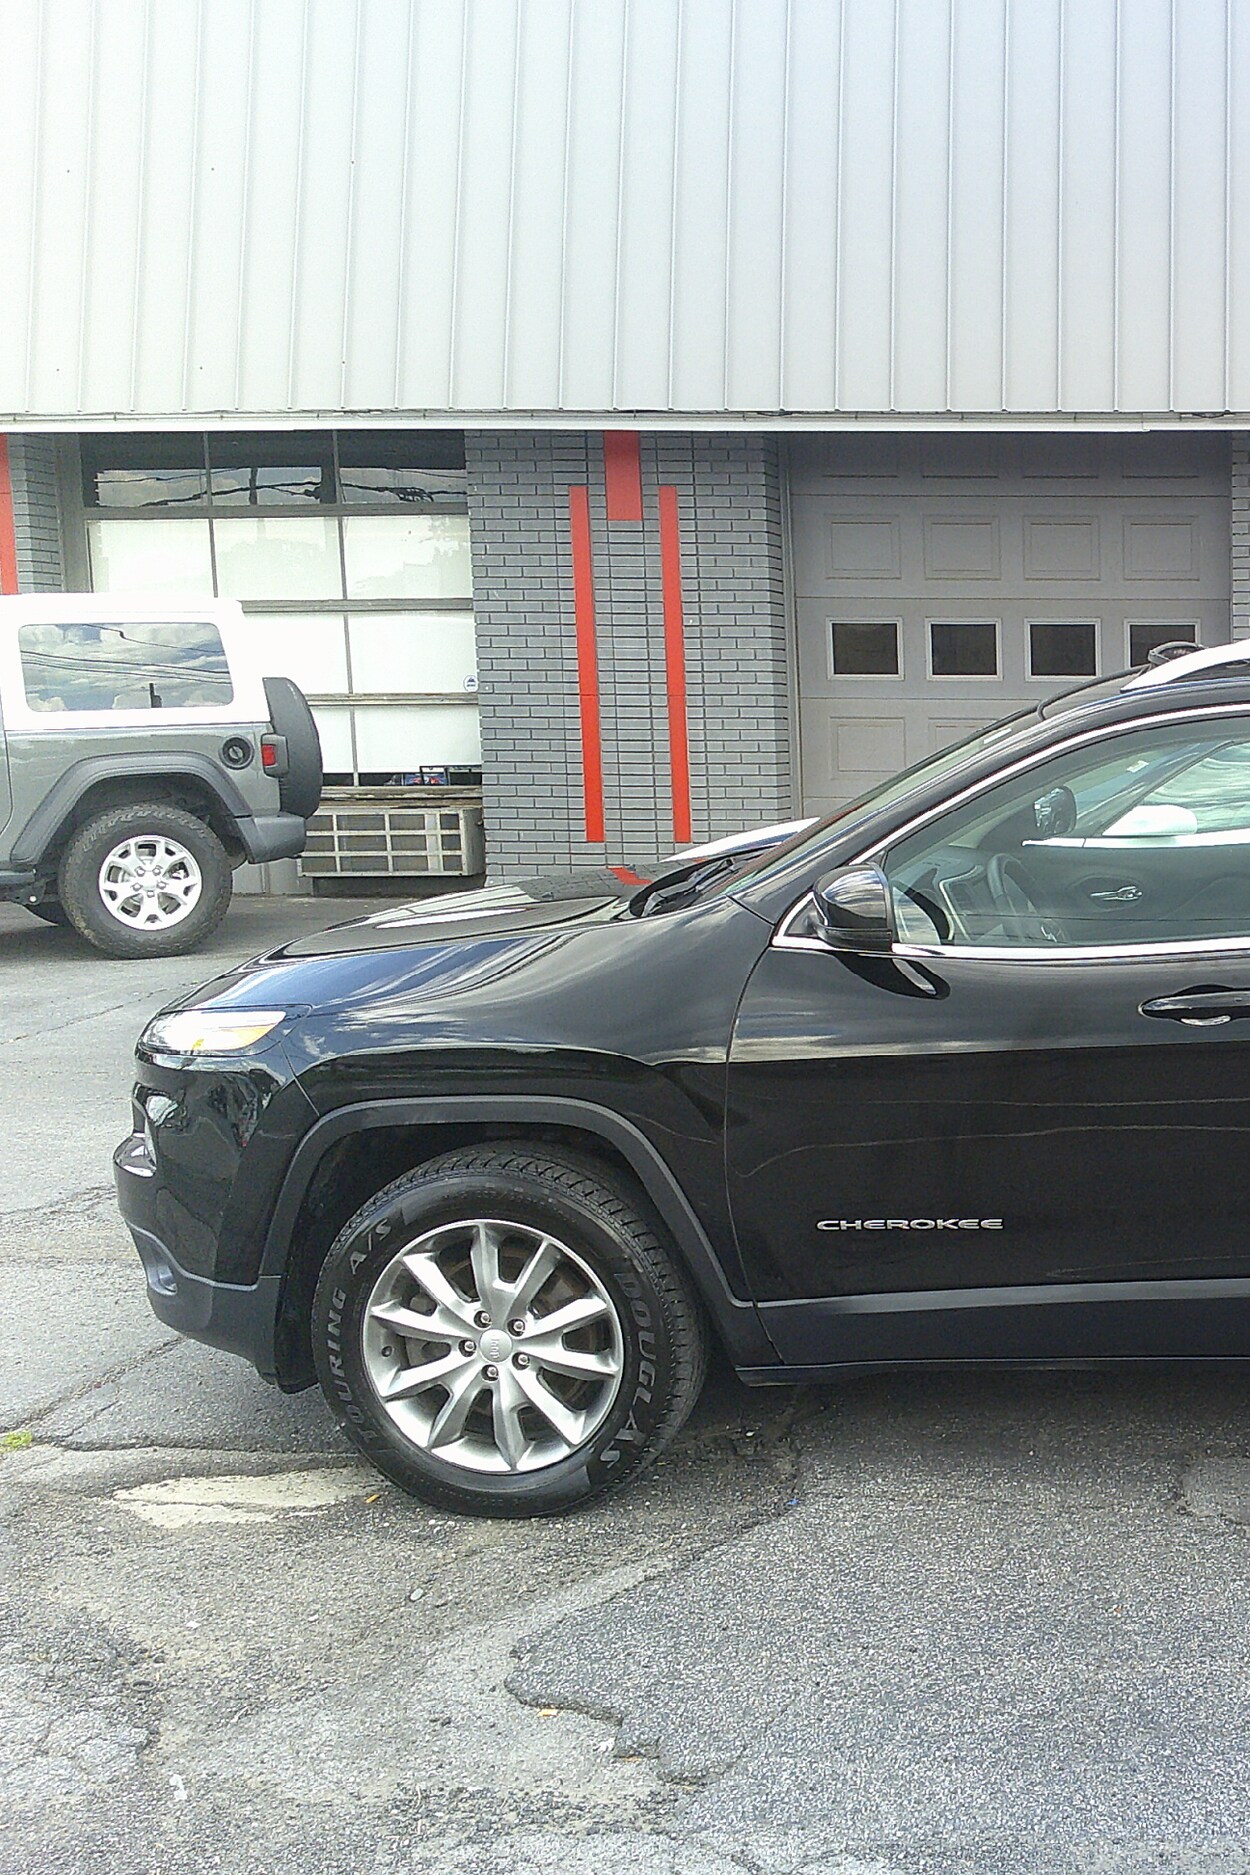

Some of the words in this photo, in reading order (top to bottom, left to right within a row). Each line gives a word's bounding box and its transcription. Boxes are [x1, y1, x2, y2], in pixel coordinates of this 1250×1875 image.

[349, 1218, 393, 1276] A/S
[816, 1218, 1004, 1231] CHEROKEE
[326, 1287, 379, 1444] TOURING
[599, 1272, 657, 1470] DOUGLAS
